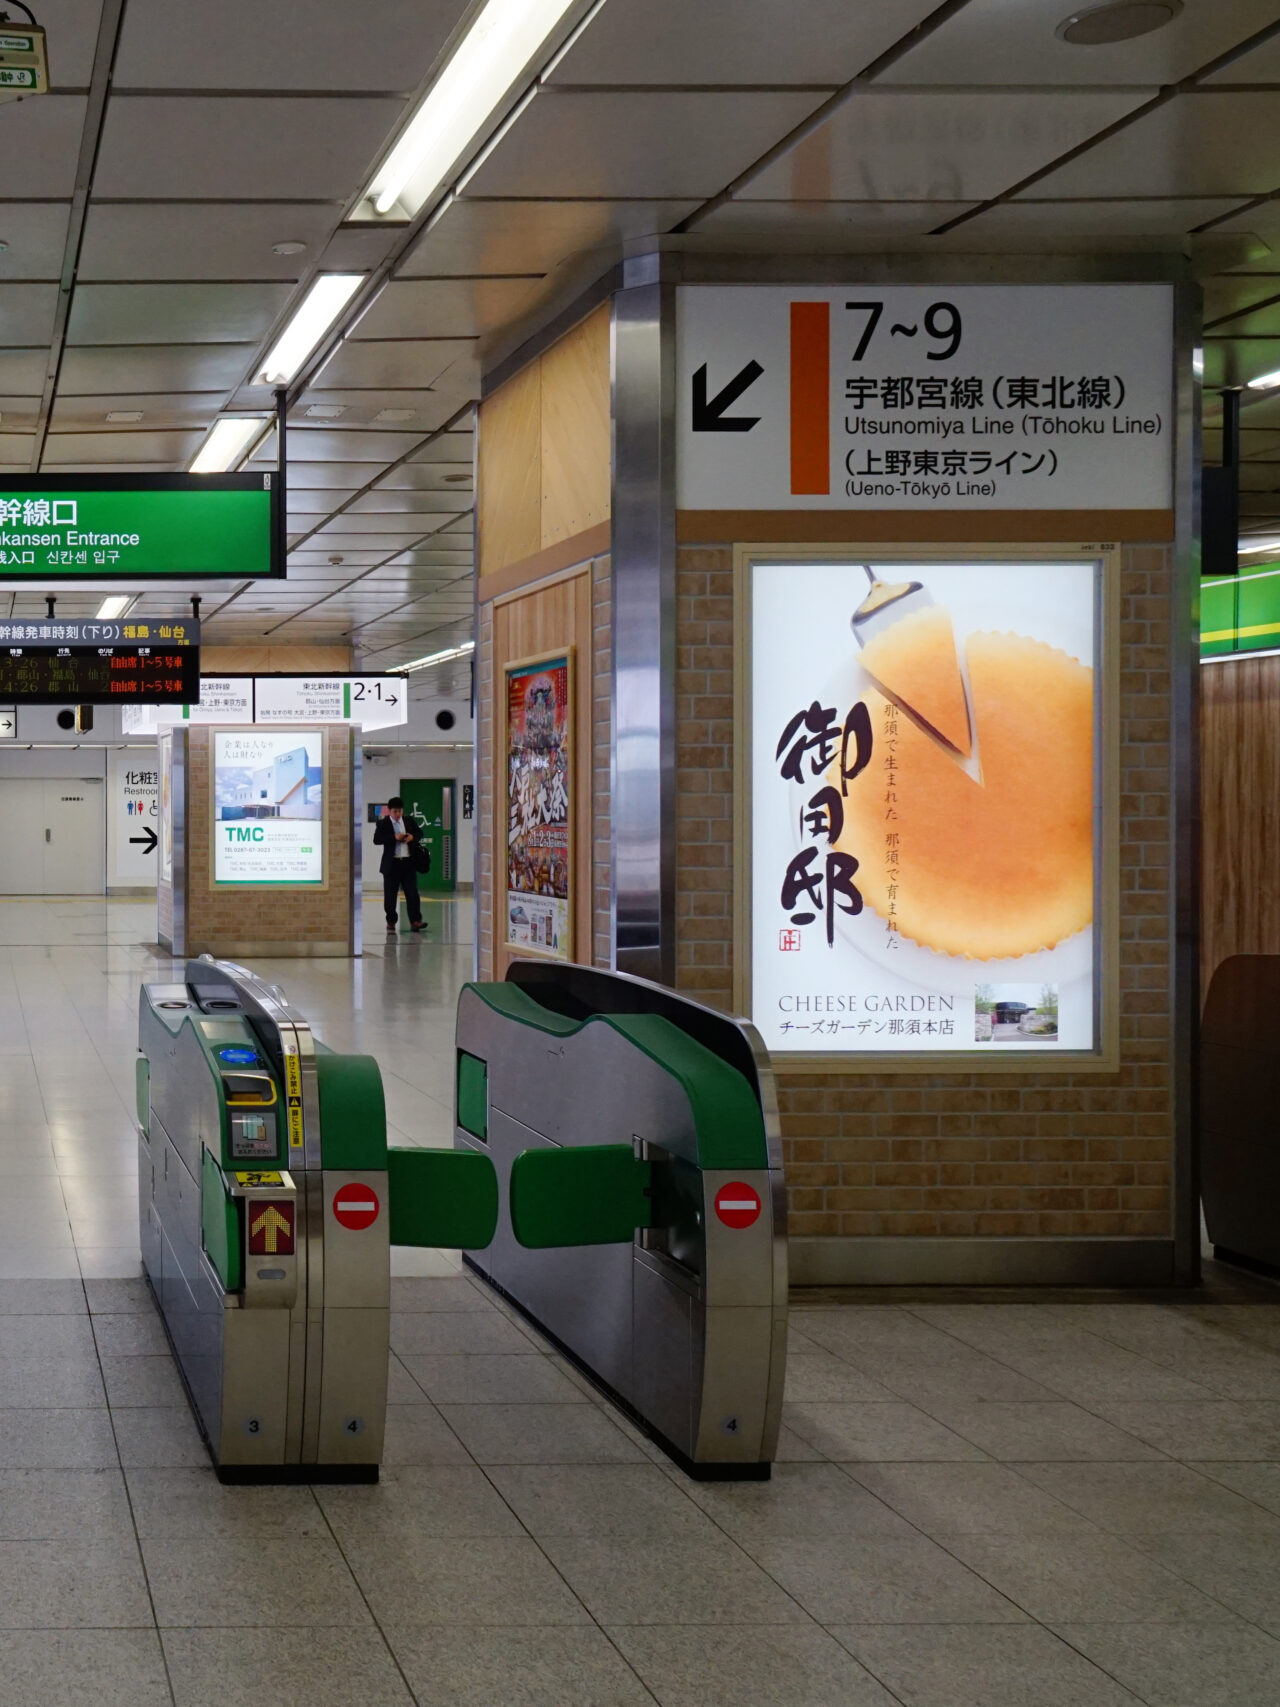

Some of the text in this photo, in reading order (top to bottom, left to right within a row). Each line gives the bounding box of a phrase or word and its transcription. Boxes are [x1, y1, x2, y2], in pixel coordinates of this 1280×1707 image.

[844, 375, 1127, 410] 宇都宮線（東北線）
[844, 416, 1163, 438] Utsunomiya Line (Tōhoku Line)
[844, 449, 1059, 477] （上野東京ライン）
[956, 479, 997, 498] Line)
[67, 530, 140, 547] Entrance
[46, 550, 88, 565] 신칸센
[93, 550, 121, 565] 입구
[123, 625, 186, 639] 福島・仙台
[303, 682, 340, 691] 東北新幹線
[194, 698, 248, 707] 宮・上野・東京方面
[123, 787, 158, 795] Restroo
[224, 826, 265, 843] TMC
[882, 703, 901, 951] 那須で生まれた 那須で育まれた
[778, 994, 955, 1013] CHEESE GARDEN
[779, 1018, 956, 1036] チーズガーデン那須本店
[288, 1055, 298, 1095] かけこみ禁止
[248, 1420, 260, 1433] 3
[347, 1419, 358, 1433] 4
[726, 1418, 737, 1431] 4
